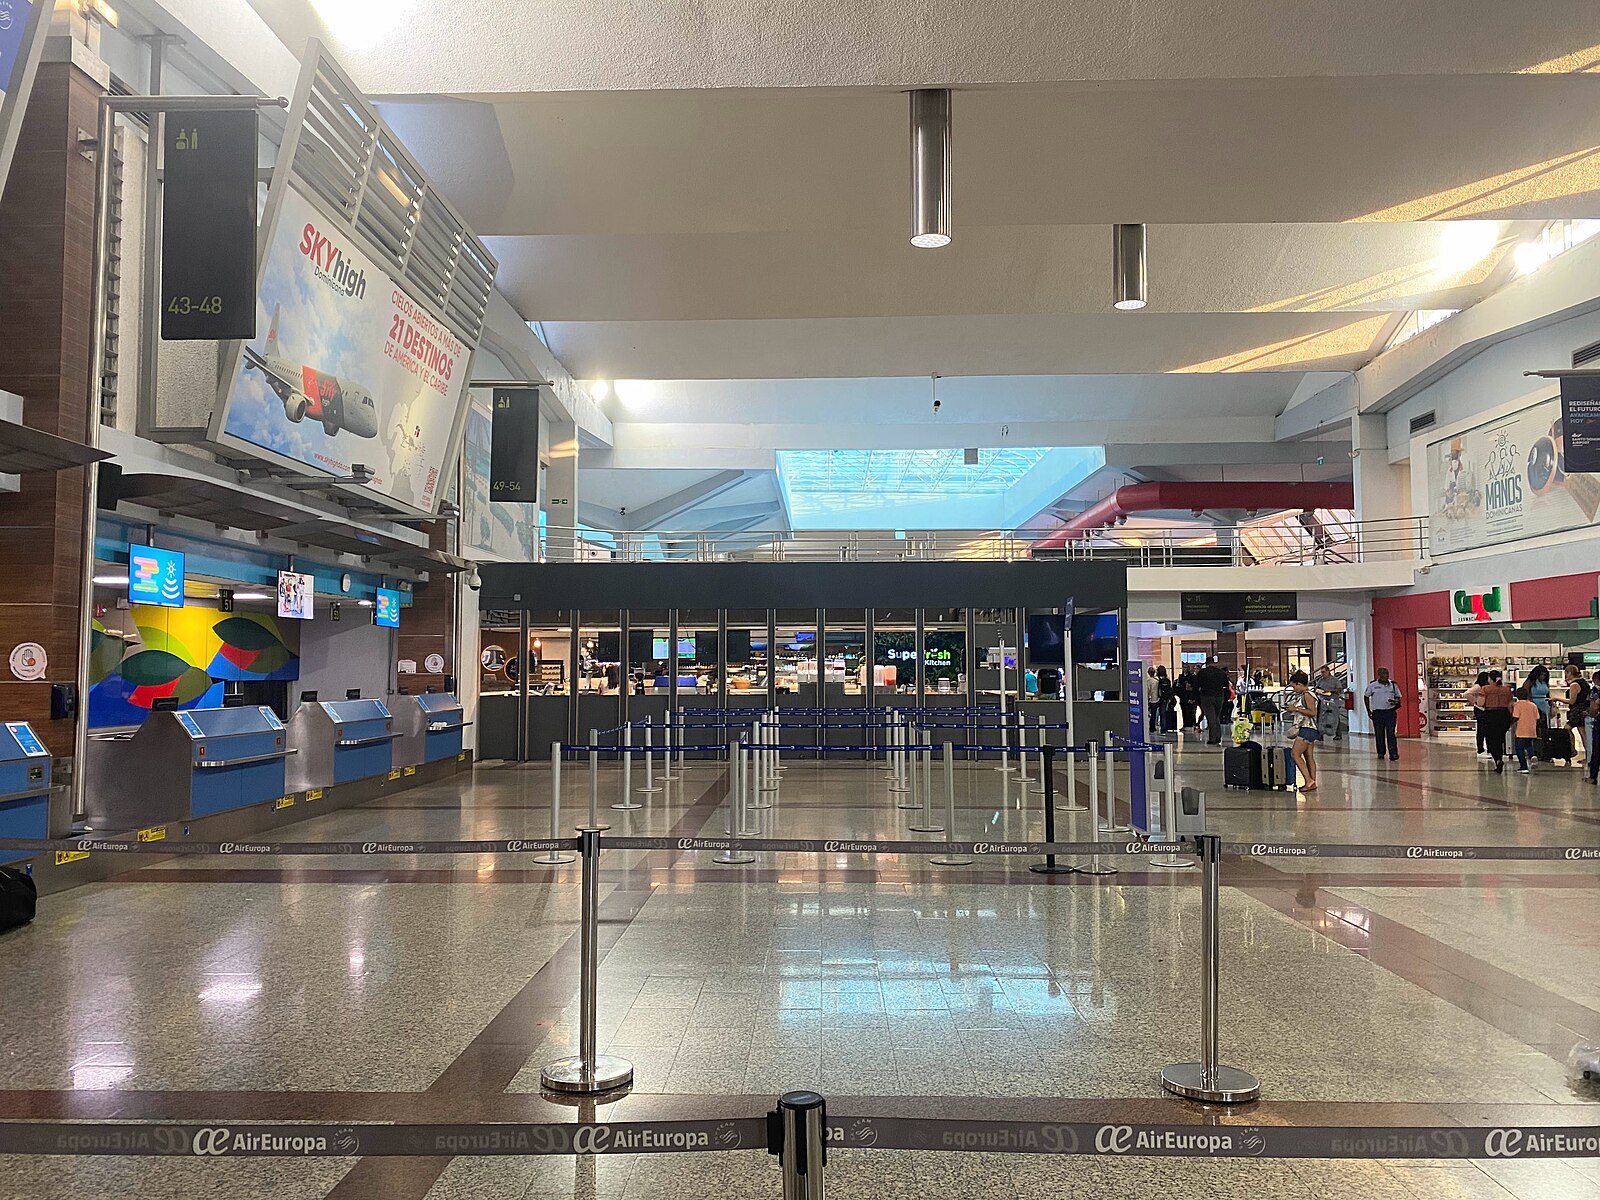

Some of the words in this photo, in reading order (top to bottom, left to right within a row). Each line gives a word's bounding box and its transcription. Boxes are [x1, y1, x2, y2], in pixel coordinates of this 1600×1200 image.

[167, 296, 222, 314] 43-48
[391, 290, 413, 317] CIELOS
[412, 309, 439, 339] ABIERTOS
[453, 345, 462, 358] DE
[388, 313, 405, 344] 21
[403, 324, 454, 380] DESTINOS
[383, 340, 394, 357] DE
[430, 375, 448, 396] CARIBE
[493, 481, 521, 491] 49-54
[1485, 474, 1523, 511] MANOS
[1485, 503, 1523, 520] DOMINICANAS
[887, 649, 918, 661] Supe
[92, 842, 128, 851] AirEuropa
[234, 844, 271, 853] AirEuropa
[377, 844, 414, 853] AirEuropa
[522, 841, 559, 850] AirEuropa
[692, 840, 730, 849] AirEuropa
[839, 842, 877, 851] AirEuropa
[989, 844, 1028, 853] AirEuropa
[1142, 843, 1181, 853] AirEuropa
[1267, 846, 1306, 855] AirEuropa
[1423, 848, 1463, 858] AirEuropa
[1581, 849, 1600, 857] AirE
[232, 1132, 326, 1152] AirEuropa
[613, 1130, 709, 1151] AirEuropa
[1135, 1130, 1232, 1153] AirEuropa
